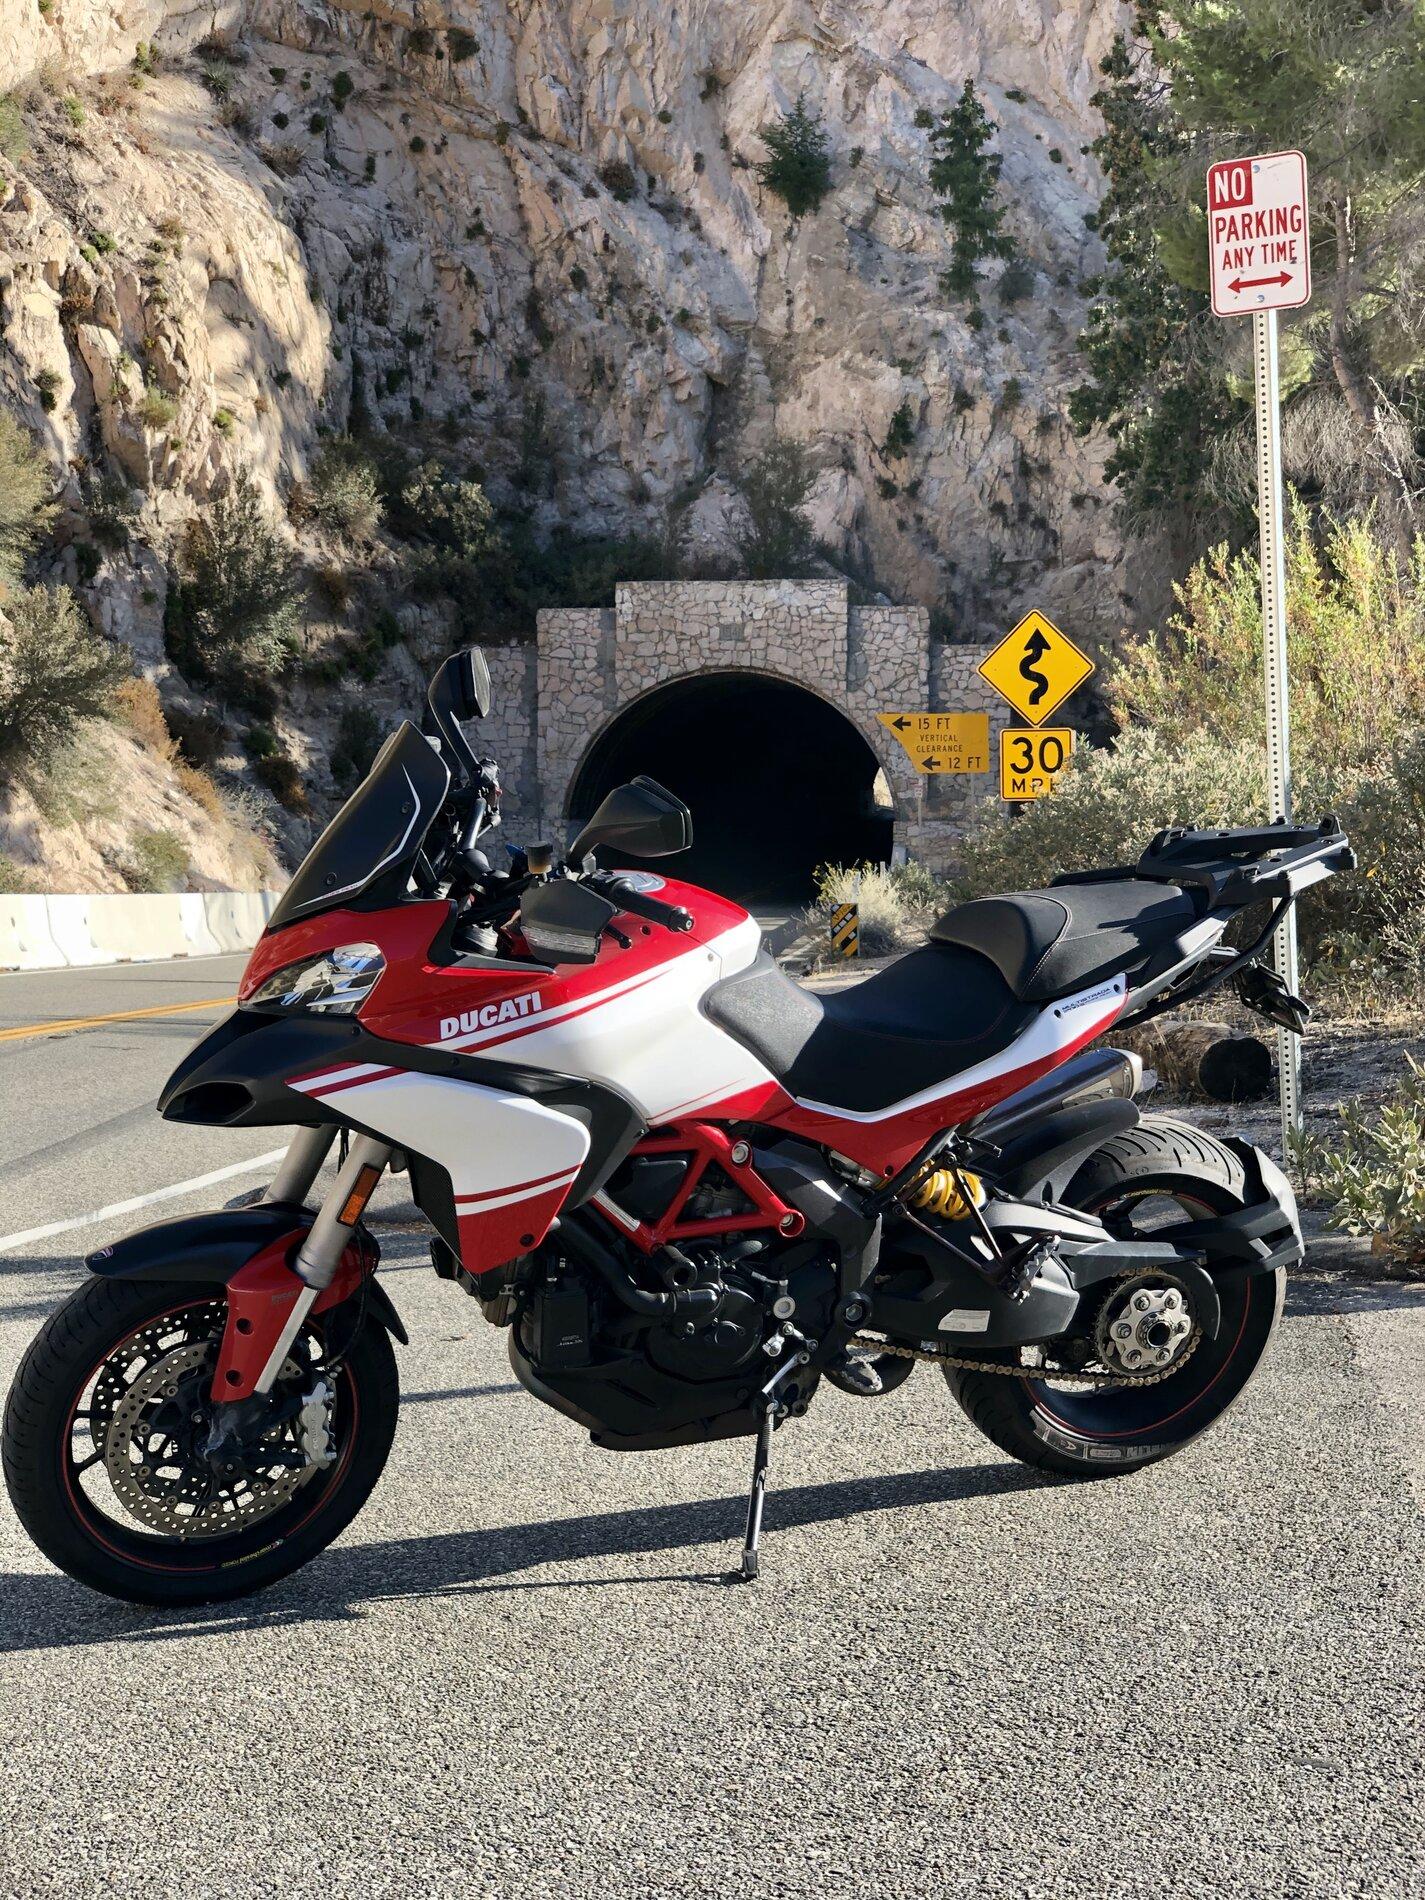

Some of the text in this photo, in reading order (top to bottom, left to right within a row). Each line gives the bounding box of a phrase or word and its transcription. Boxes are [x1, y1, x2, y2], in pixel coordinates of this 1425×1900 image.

[1214, 167, 1246, 203] NO
[1215, 204, 1302, 244] PARKING
[1222, 239, 1298, 270] ANY TIME
[918, 717, 951, 730] 15 FT
[920, 734, 958, 742] VERTICAL
[916, 744, 963, 753] CLEARANCE
[948, 756, 981, 769] 12 FT
[1010, 736, 1064, 774] 30
[440, 990, 542, 1040] DUCATI
